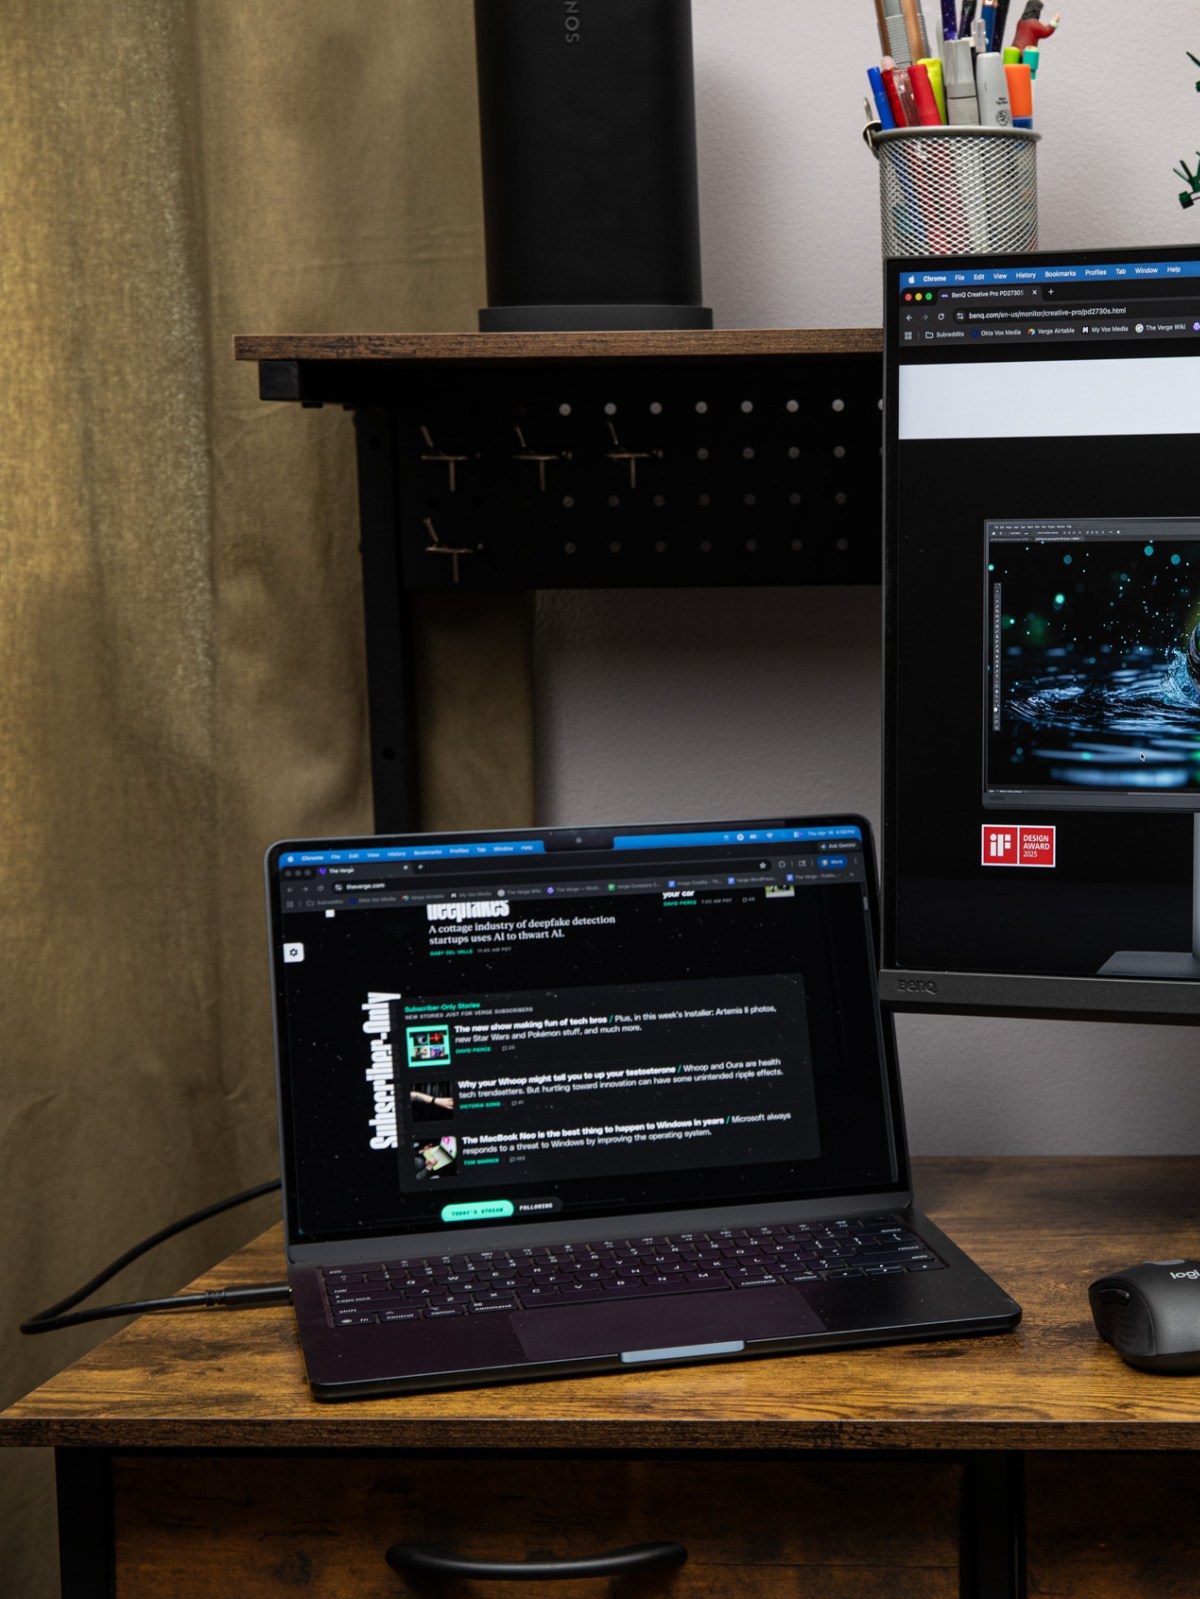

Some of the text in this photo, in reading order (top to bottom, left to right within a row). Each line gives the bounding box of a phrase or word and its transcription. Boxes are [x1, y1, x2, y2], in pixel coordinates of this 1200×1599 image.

[923, 274, 947, 282] Chrome
[954, 273, 965, 281] File
[993, 272, 1007, 280] View
[1015, 271, 1036, 280] History
[1044, 270, 1077, 278] Bookmarks
[1085, 268, 1107, 276] Profiles
[1115, 267, 1126, 275] Tab
[1134, 266, 1158, 274] Window
[1167, 266, 1181, 274] Help
[951, 291, 966, 299] BenQ
[967, 290, 989, 298] Creative
[968, 307, 1127, 320] benq.com/en-us/monitor/creative-pro/pd2730s.html
[980, 329, 993, 337] Okta
[1037, 327, 1075, 336] Verge Airtable
[1156, 324, 1172, 332] Verge
[1023, 834, 1049, 842] DESIGN
[1023, 850, 1038, 858] 2025
[662, 890, 680, 900] your
[428, 915, 616, 934] A cottage industry of deepfake detection
[429, 935, 469, 946] startups
[471, 934, 492, 943] uses
[493, 932, 505, 941] AI
[506, 932, 517, 940] to
[518, 930, 550, 940] thwart
[462, 1116, 725, 1145] The MacBook Neo is the best thing to happen to Windows in years
[1169, 1269, 1200, 1280] logi
